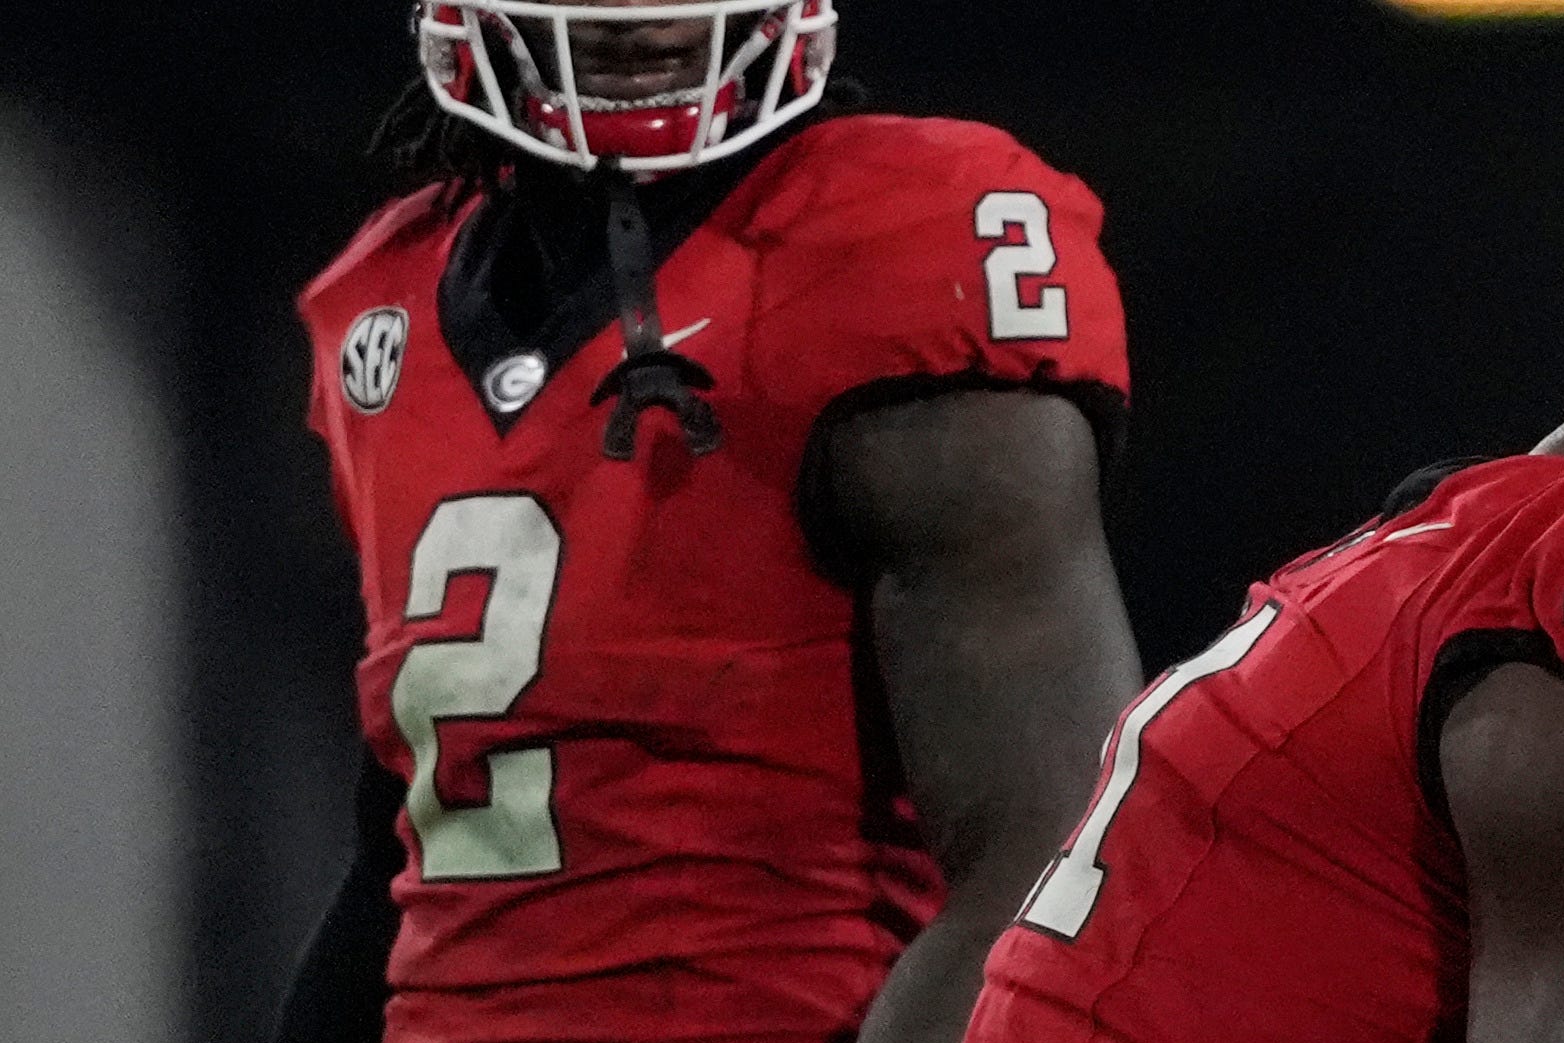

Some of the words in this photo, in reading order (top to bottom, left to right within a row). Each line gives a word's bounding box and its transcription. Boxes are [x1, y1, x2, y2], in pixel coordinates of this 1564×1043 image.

[342, 312, 405, 406] SEC
[973, 189, 1070, 342] 2
[390, 492, 563, 881] 2
[1012, 599, 1284, 942] 1
